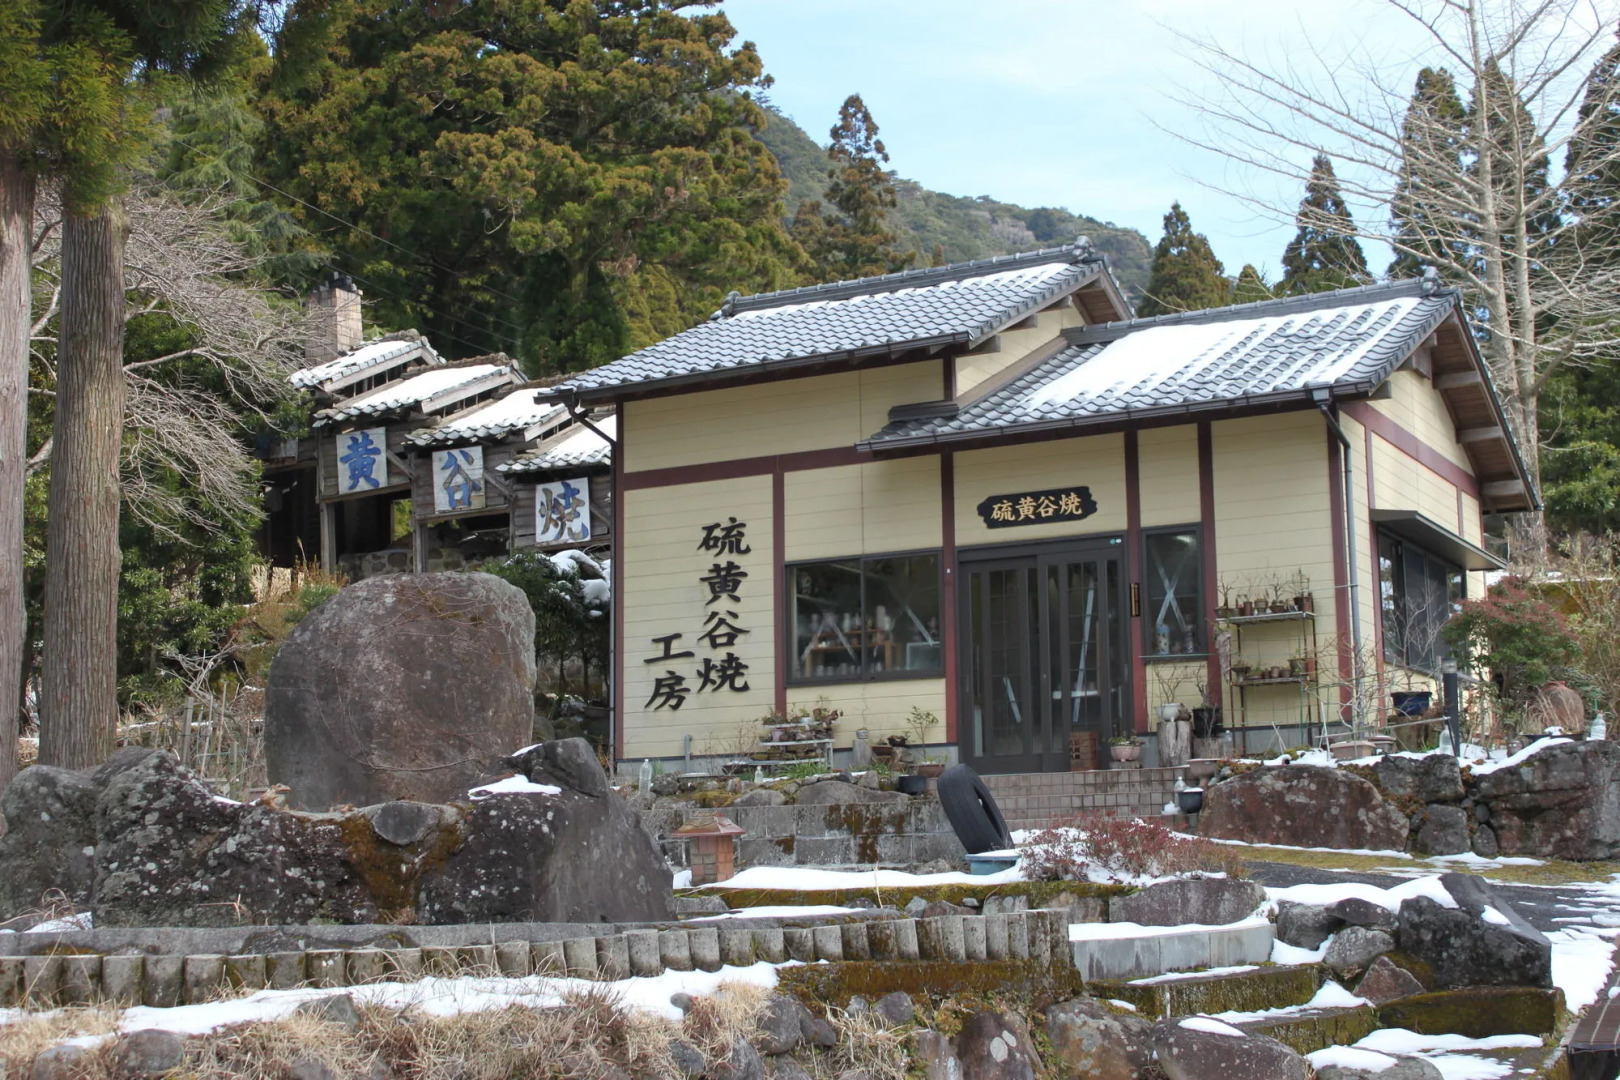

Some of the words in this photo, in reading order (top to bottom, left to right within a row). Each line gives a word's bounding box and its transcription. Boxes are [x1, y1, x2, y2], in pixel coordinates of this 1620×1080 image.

[339, 431, 382, 491] 黄
[440, 449, 482, 510] 谷
[538, 481, 589, 541] 焼
[990, 491, 1083, 522] 硫黄谷焼
[696, 516, 752, 693] 硫黄谷焼
[643, 632, 696, 711] 工房
